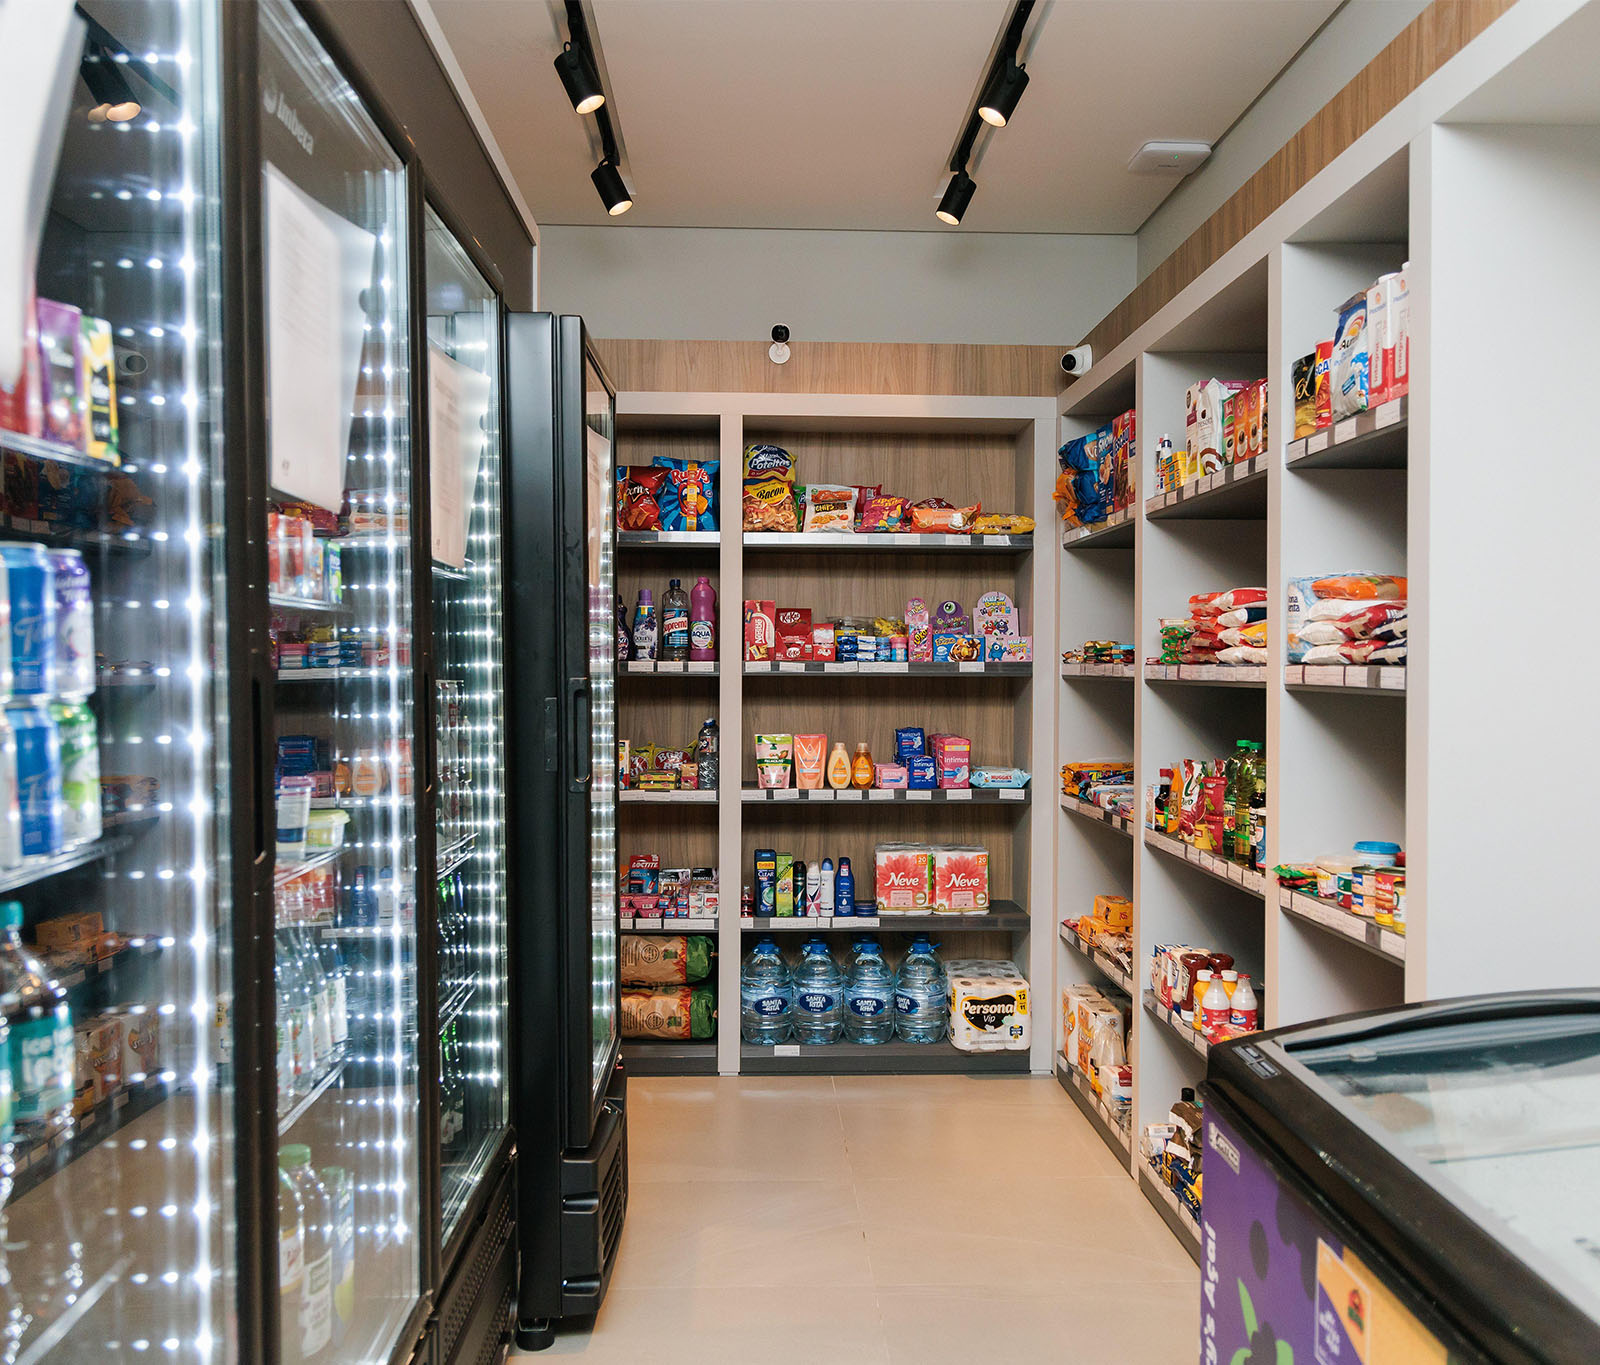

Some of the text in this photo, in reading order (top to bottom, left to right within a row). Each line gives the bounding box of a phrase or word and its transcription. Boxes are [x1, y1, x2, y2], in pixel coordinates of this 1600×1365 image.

[756, 486, 785, 500] Bacon
[692, 630, 711, 638] AQUA
[944, 755, 969, 763] Intimus
[919, 856, 927, 864] 20
[884, 871, 920, 887] Neve
[945, 872, 981, 888] Neve
[762, 998, 783, 1006] SANTA
[805, 995, 826, 1003] SANTA
[856, 999, 877, 1007] SANTA
[962, 1000, 1017, 1014] Personal
[983, 1014, 996, 1024] Vip
[1203, 1313, 1217, 1365] y's
